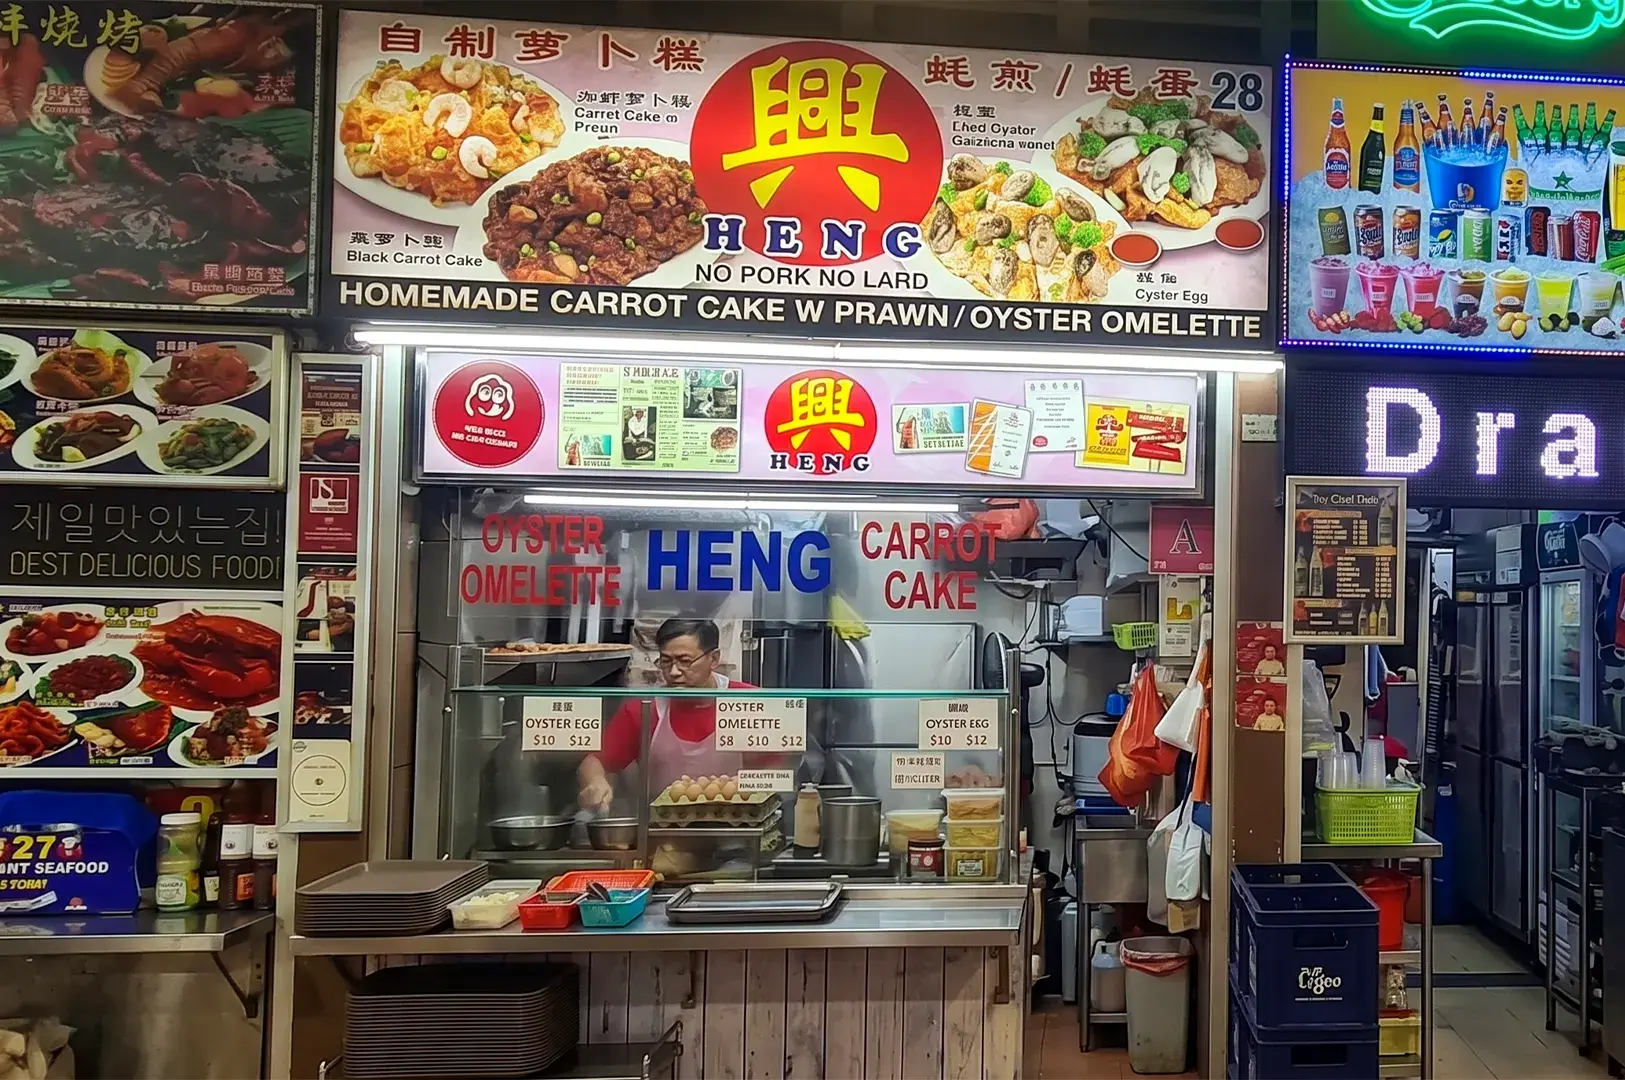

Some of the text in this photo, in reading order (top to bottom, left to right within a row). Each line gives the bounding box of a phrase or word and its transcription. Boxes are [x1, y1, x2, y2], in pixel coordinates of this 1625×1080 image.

[379, 23, 704, 73] 自制萝卜糕
[1212, 71, 1264, 112] 28
[722, 56, 909, 212] 興
[704, 217, 923, 258] HENG
[347, 250, 483, 267] Black Carrot Cake
[695, 264, 929, 290] NO PORK NO LARD
[339, 281, 539, 312] HOMEMADE
[550, 289, 688, 319] CARROT
[697, 295, 785, 323] CAKE
[795, 299, 825, 323] W
[1102, 310, 1262, 338] OMELETTE
[1183, 290, 1208, 304] Egg
[777, 376, 864, 451] 興
[1365, 387, 1600, 479] Dra
[769, 452, 870, 473] HENG
[482, 514, 604, 555] OYSTER
[861, 521, 1002, 562] CARROT
[1169, 518, 1202, 554] A
[647, 529, 831, 594] HENG
[460, 564, 622, 607] OMELETTE
[884, 570, 978, 611] CAKE
[718, 702, 764, 712] OYSTER
[525, 718, 600, 730] OYSTER EGG
[718, 718, 781, 730] OMELETTE
[925, 718, 967, 729] OYSTER
[533, 734, 591, 747] $10 $12
[719, 734, 803, 748] $8 $10 $12
[930, 734, 987, 747] $10 $12
[11, 834, 57, 860] 27
[34, 861, 109, 874] SEAFOOD
